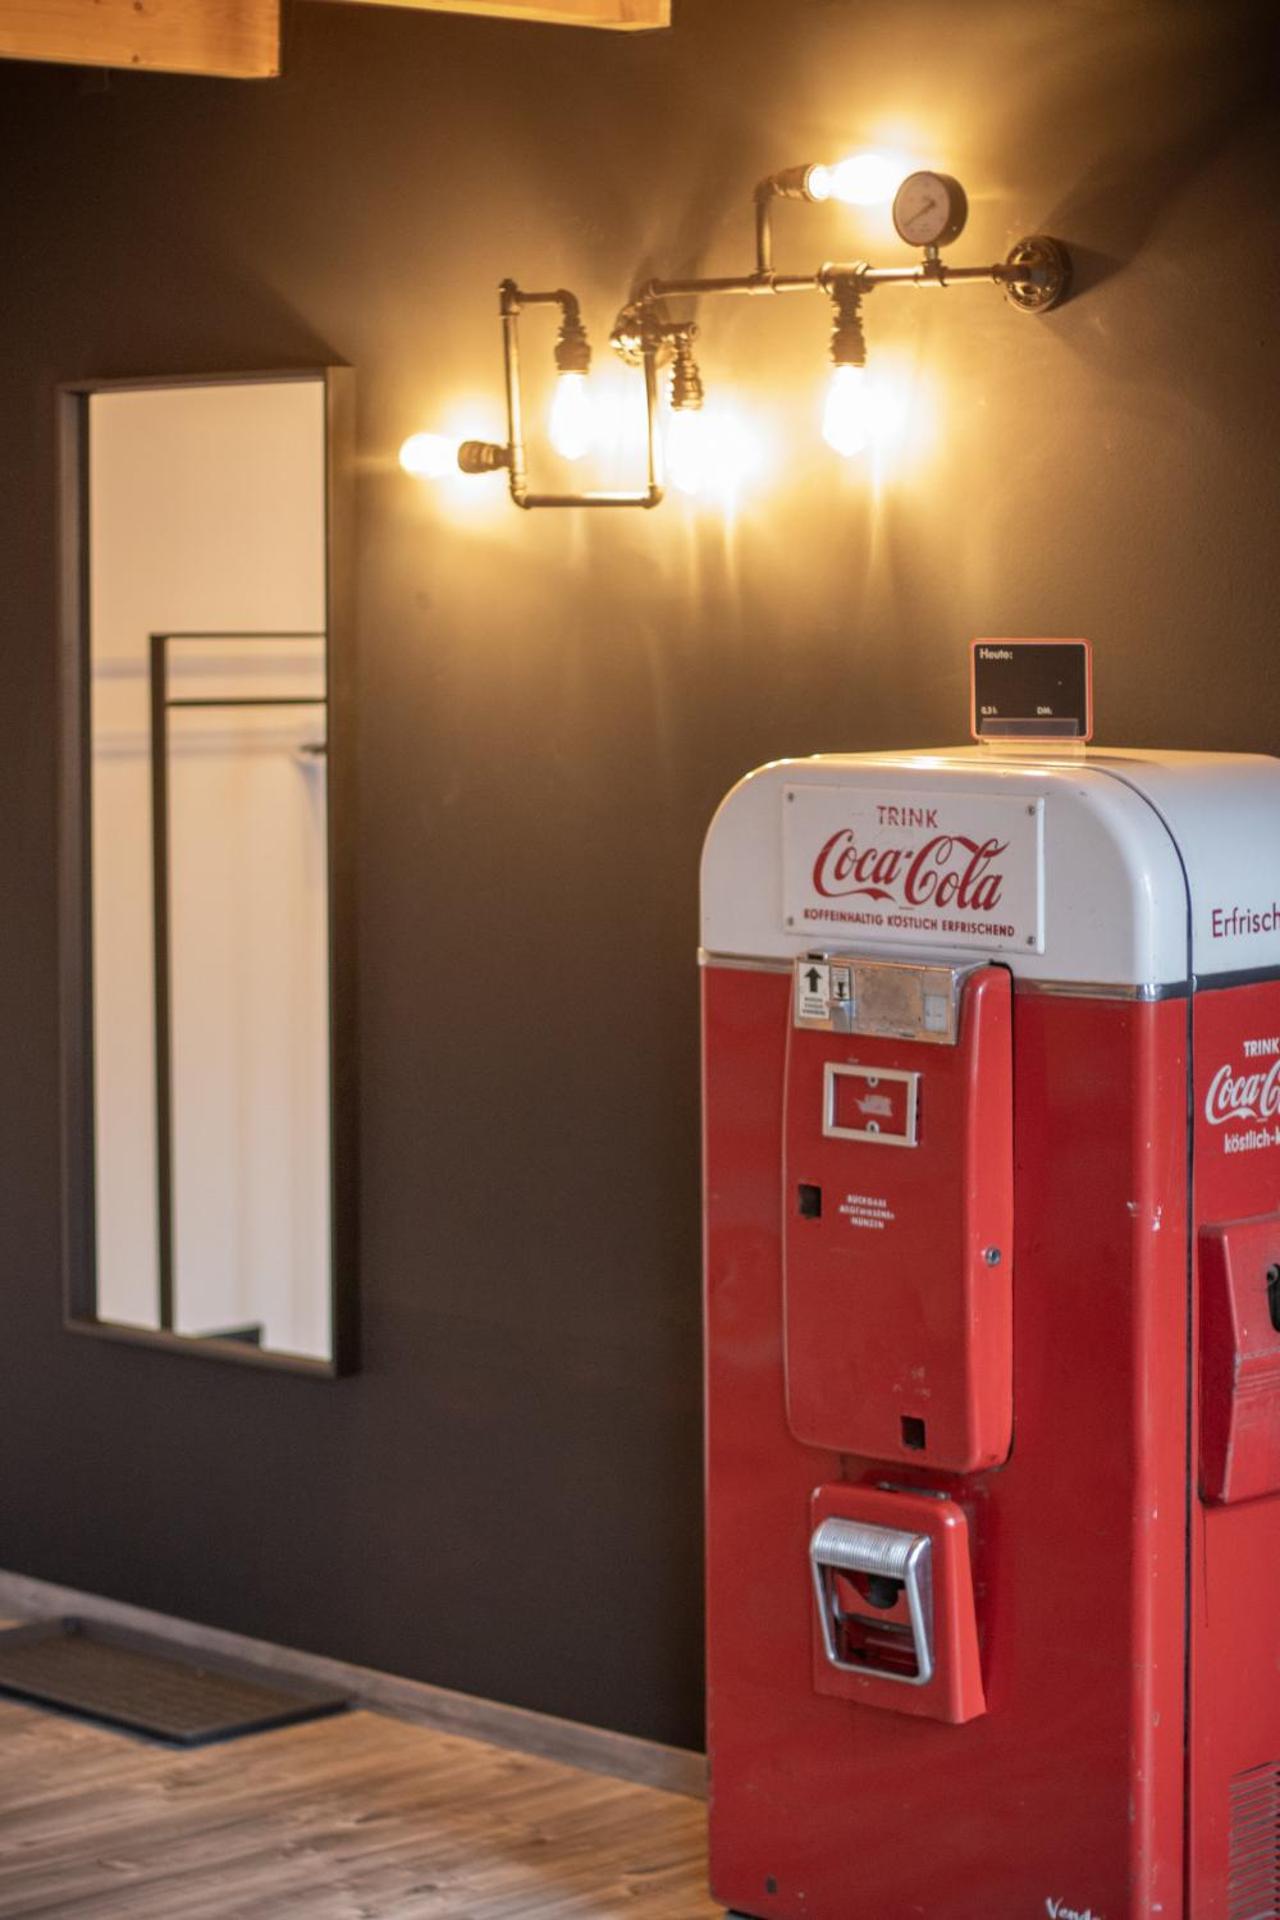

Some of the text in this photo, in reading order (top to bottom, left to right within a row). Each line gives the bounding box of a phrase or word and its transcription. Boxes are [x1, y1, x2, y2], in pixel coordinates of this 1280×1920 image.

[877, 805, 938, 828] TRINK
[813, 829, 1009, 911] Coca-Cola
[804, 908, 1015, 937] KOFFEINHALTIG KÖSTLICH ERFRISCHEND
[1243, 1037, 1280, 1057] TRINK
